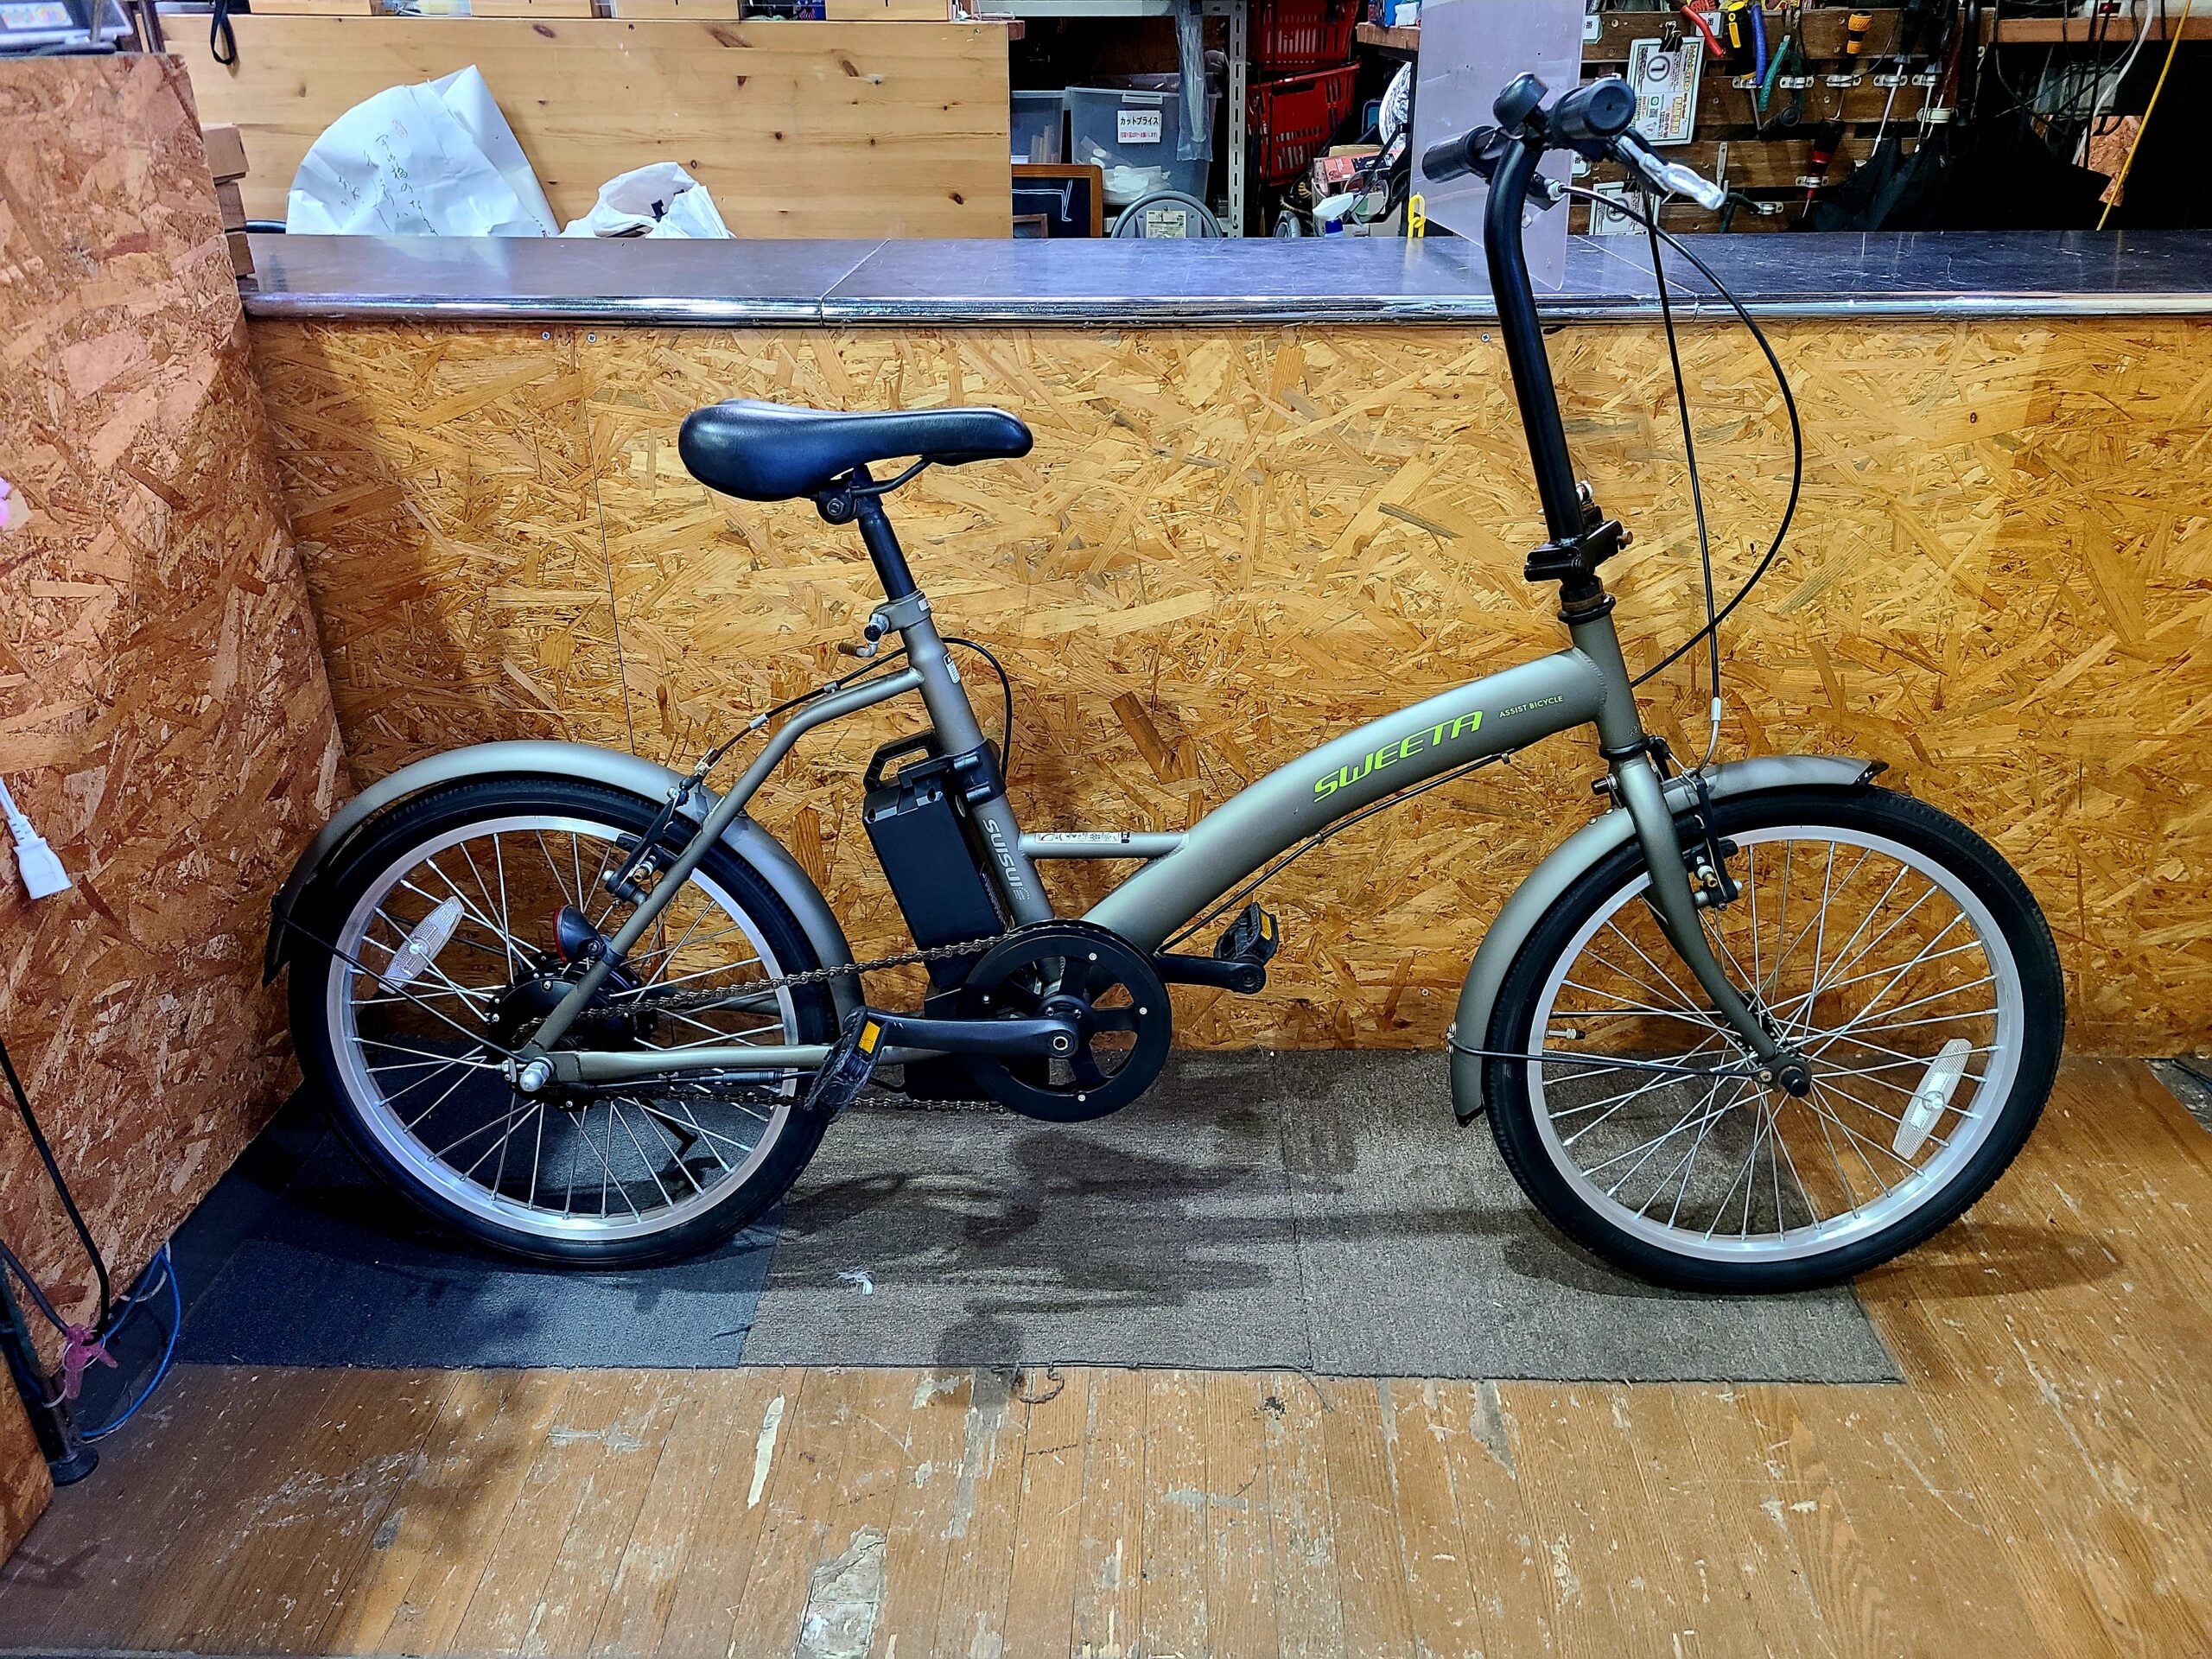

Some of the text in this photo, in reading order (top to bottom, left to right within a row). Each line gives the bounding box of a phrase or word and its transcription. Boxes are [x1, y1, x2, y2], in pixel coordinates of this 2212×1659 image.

[1120, 116, 1159, 126] カットプライス
[1498, 694, 1565, 718] ASSIST BICYCLE
[1313, 709, 1484, 803] SWEETA
[982, 817, 1024, 887] SUISUI
